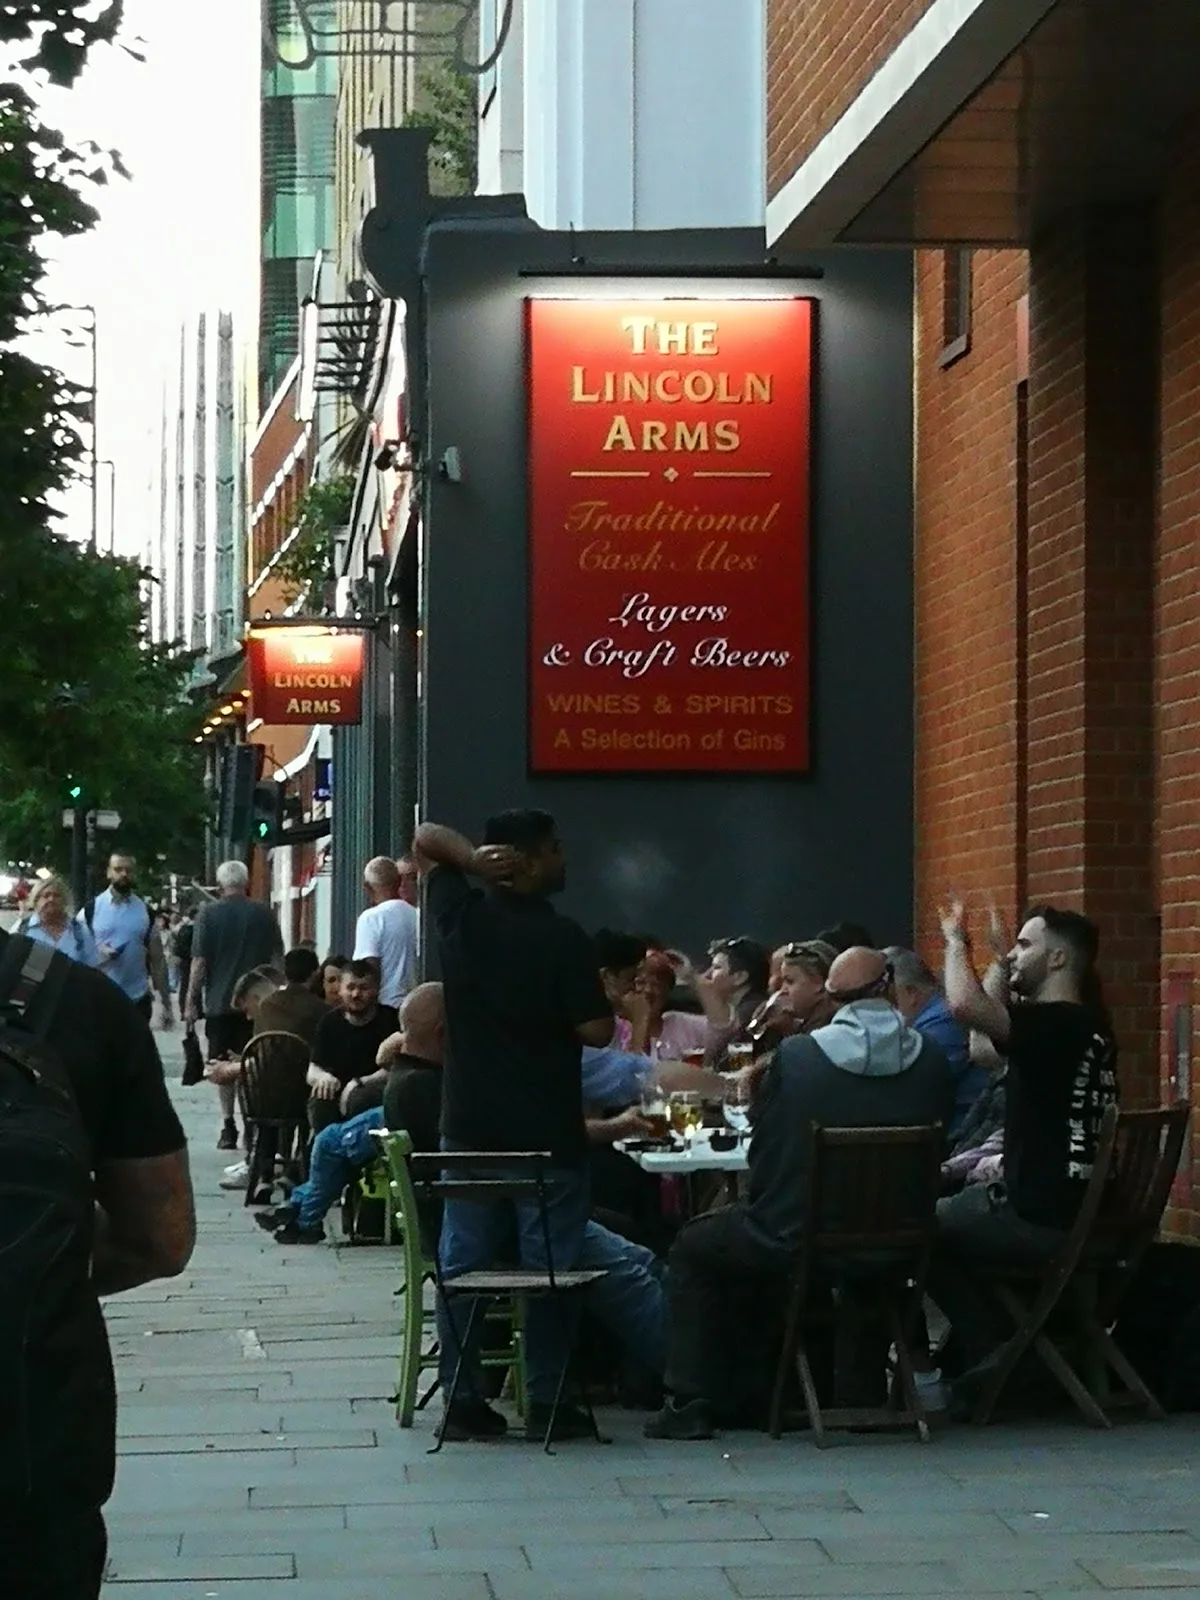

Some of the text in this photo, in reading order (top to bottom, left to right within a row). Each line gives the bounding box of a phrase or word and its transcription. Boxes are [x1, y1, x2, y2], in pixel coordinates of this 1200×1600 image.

[621, 316, 719, 355] THE
[571, 365, 773, 403] LINCOLN
[602, 415, 741, 452] ARMS
[564, 500, 780, 532] Traditional
[609, 592, 728, 632] Lagers
[543, 637, 790, 678] & Craft Beers
[274, 672, 352, 688] LINCOLN
[286, 698, 341, 714] ARMS
[548, 694, 793, 715] WINES & SPIRITS
[553, 728, 786, 751] A Selection of Gins
